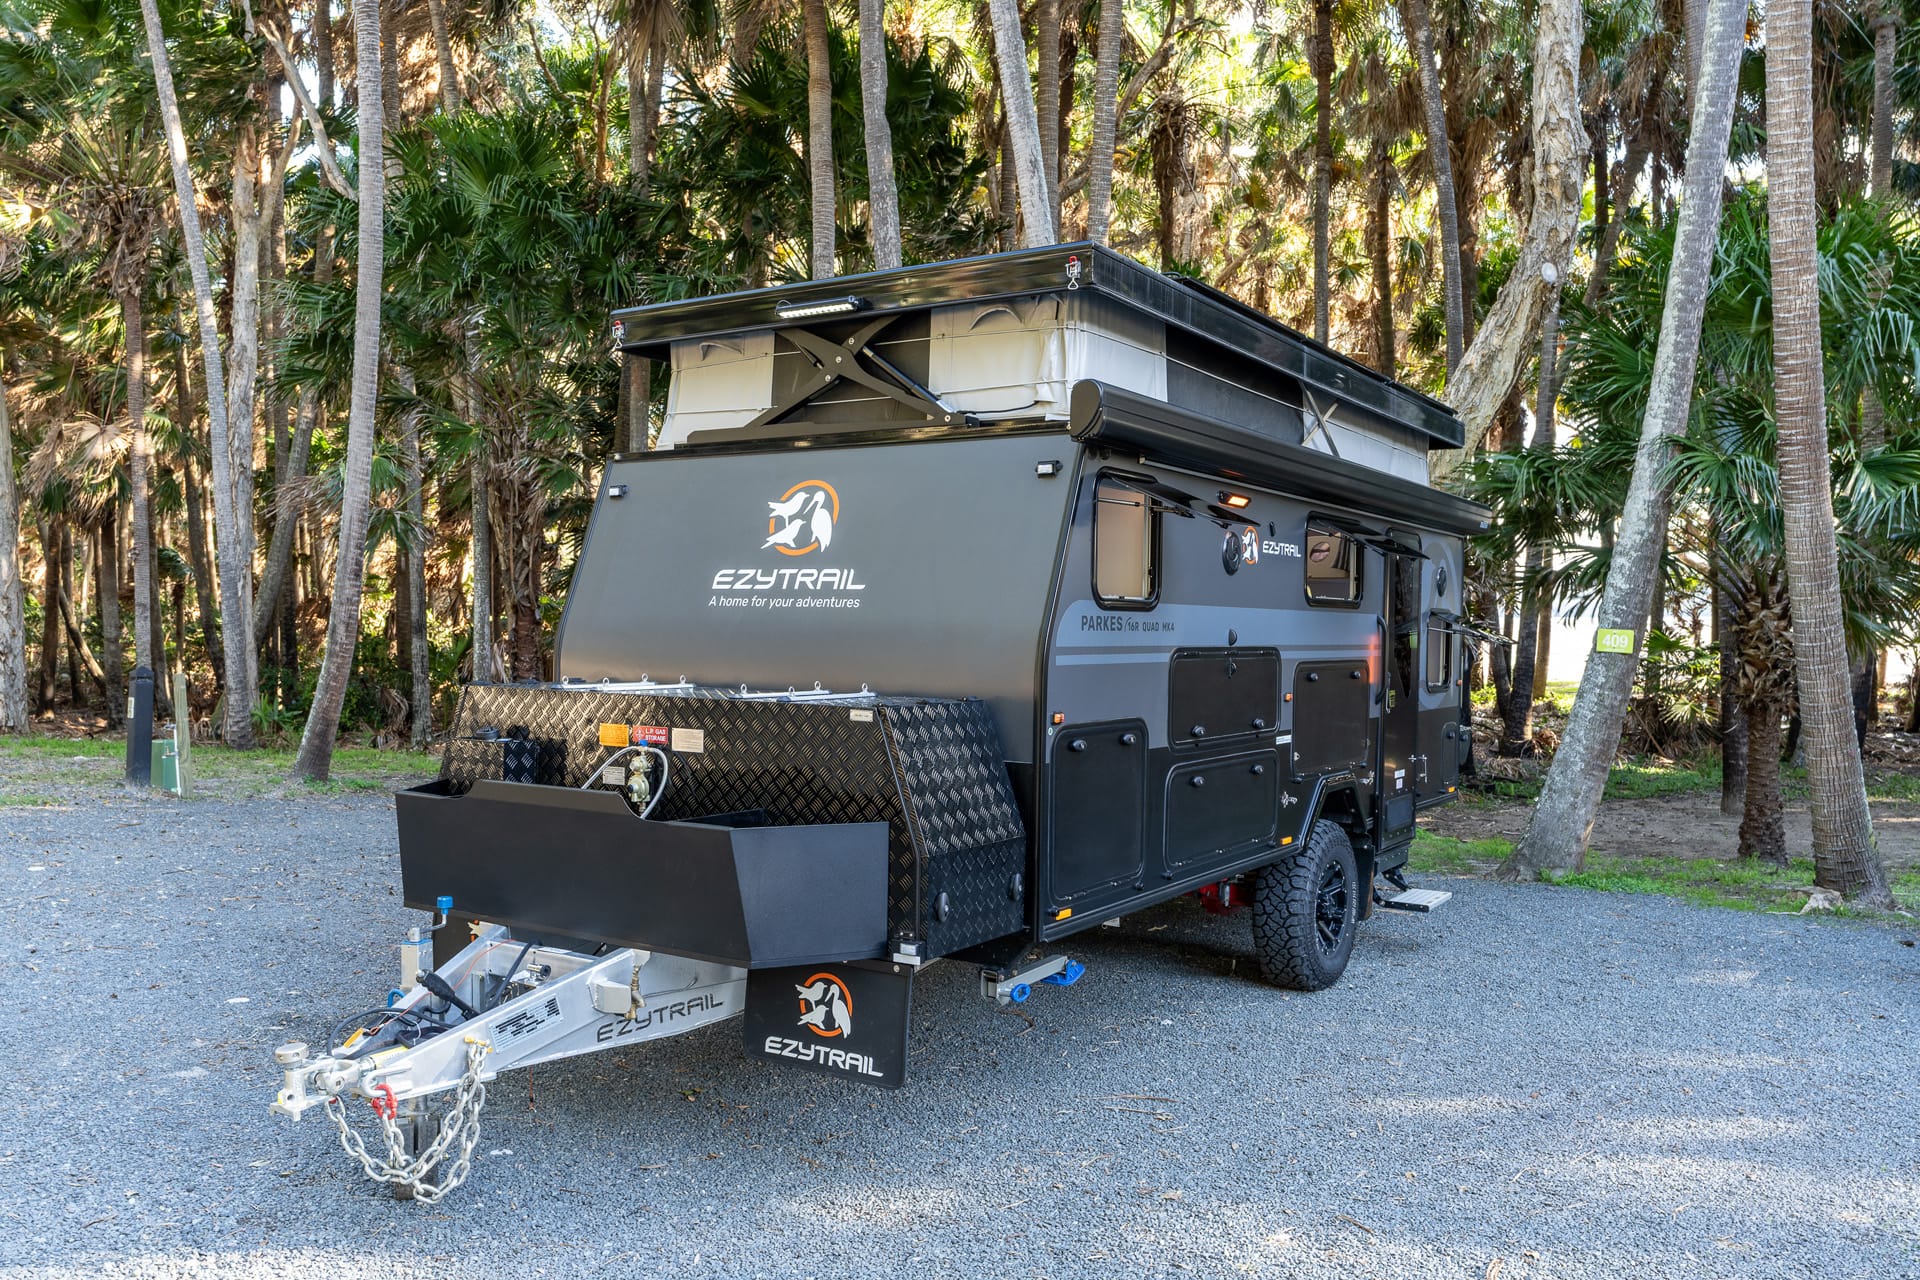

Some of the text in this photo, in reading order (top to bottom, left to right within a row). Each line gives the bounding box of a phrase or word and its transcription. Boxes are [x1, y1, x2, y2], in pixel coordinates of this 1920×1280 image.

[1262, 540, 1301, 557] EZYTRAIL
[711, 568, 866, 590] EZYTRAIL
[708, 595, 861, 609] A home for your adventures
[1081, 615, 1123, 632] PARKES
[1142, 621, 1160, 632] QUAD
[1602, 634, 1628, 648] 409
[597, 993, 724, 1042] EZYTRAIL
[764, 1036, 884, 1077] EZYTRAIL
